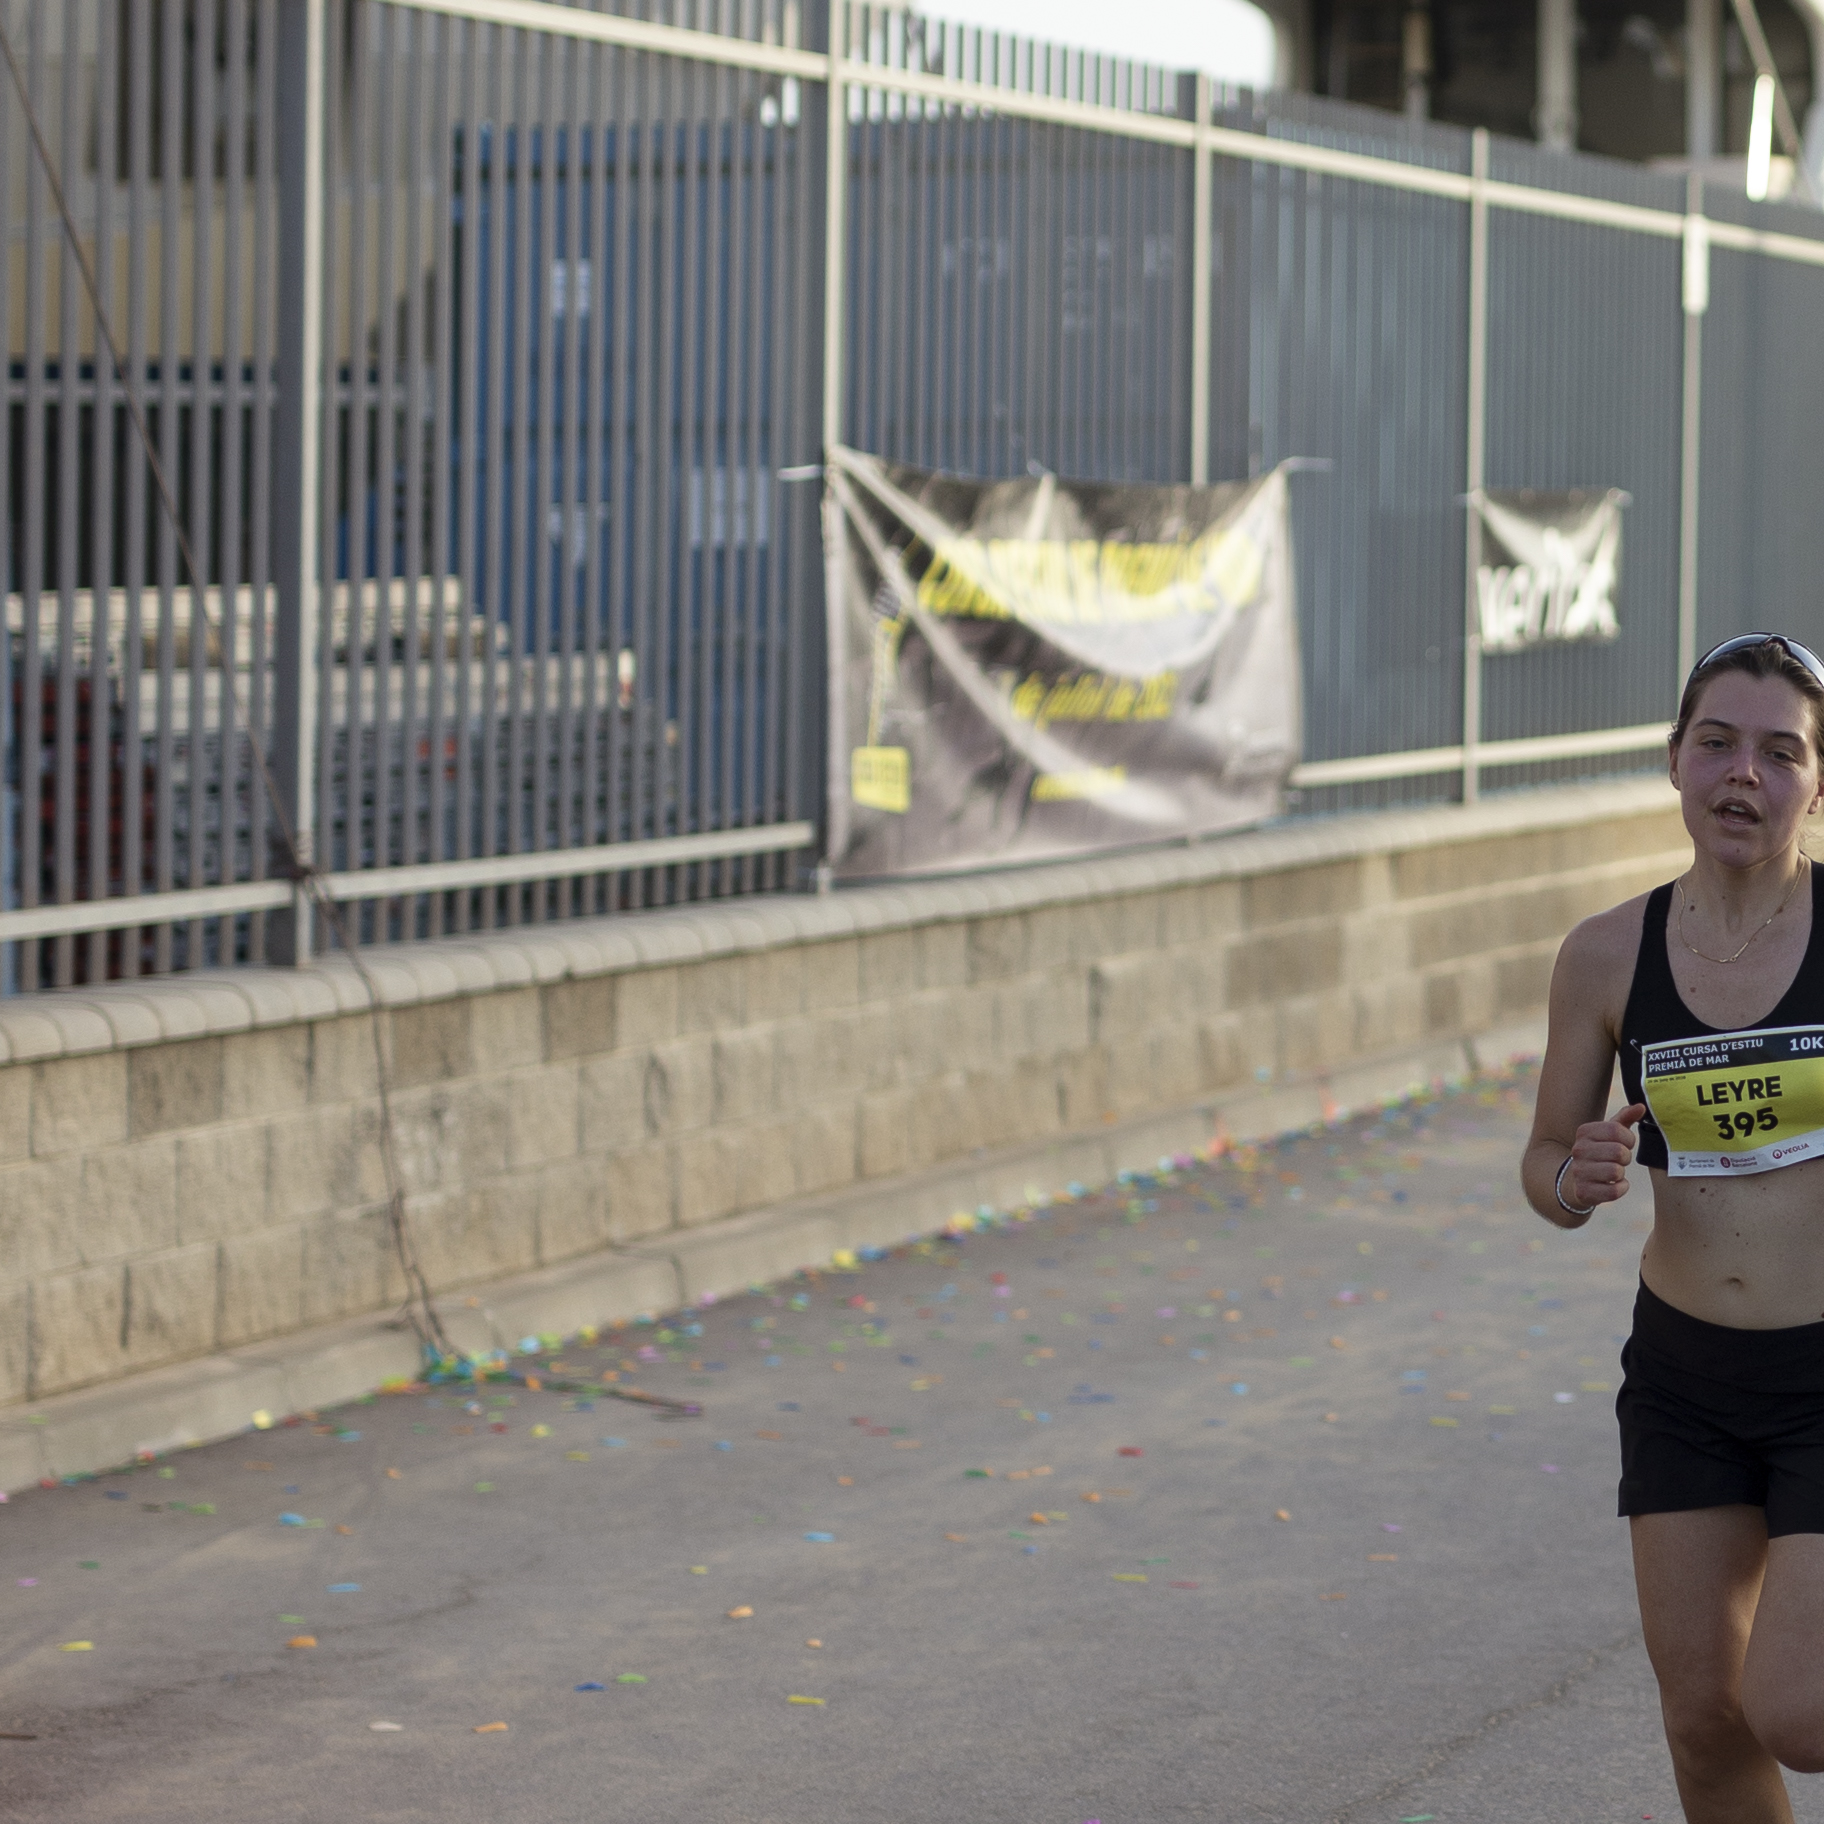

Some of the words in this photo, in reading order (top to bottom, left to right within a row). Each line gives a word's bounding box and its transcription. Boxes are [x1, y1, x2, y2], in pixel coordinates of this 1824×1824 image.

[1648, 1048, 1681, 1062] XXVIII
[1682, 1044, 1719, 1057] CURSA
[1789, 1036, 1824, 1052] 10K
[1648, 1057, 1687, 1073] PREMIÀ
[1689, 1057, 1703, 1068] DE
[1706, 1054, 1730, 1066] MAR
[1695, 1075, 1783, 1107] LEYRE
[1713, 1107, 1779, 1141] 395
[1782, 1142, 1810, 1155] VEOLIA
